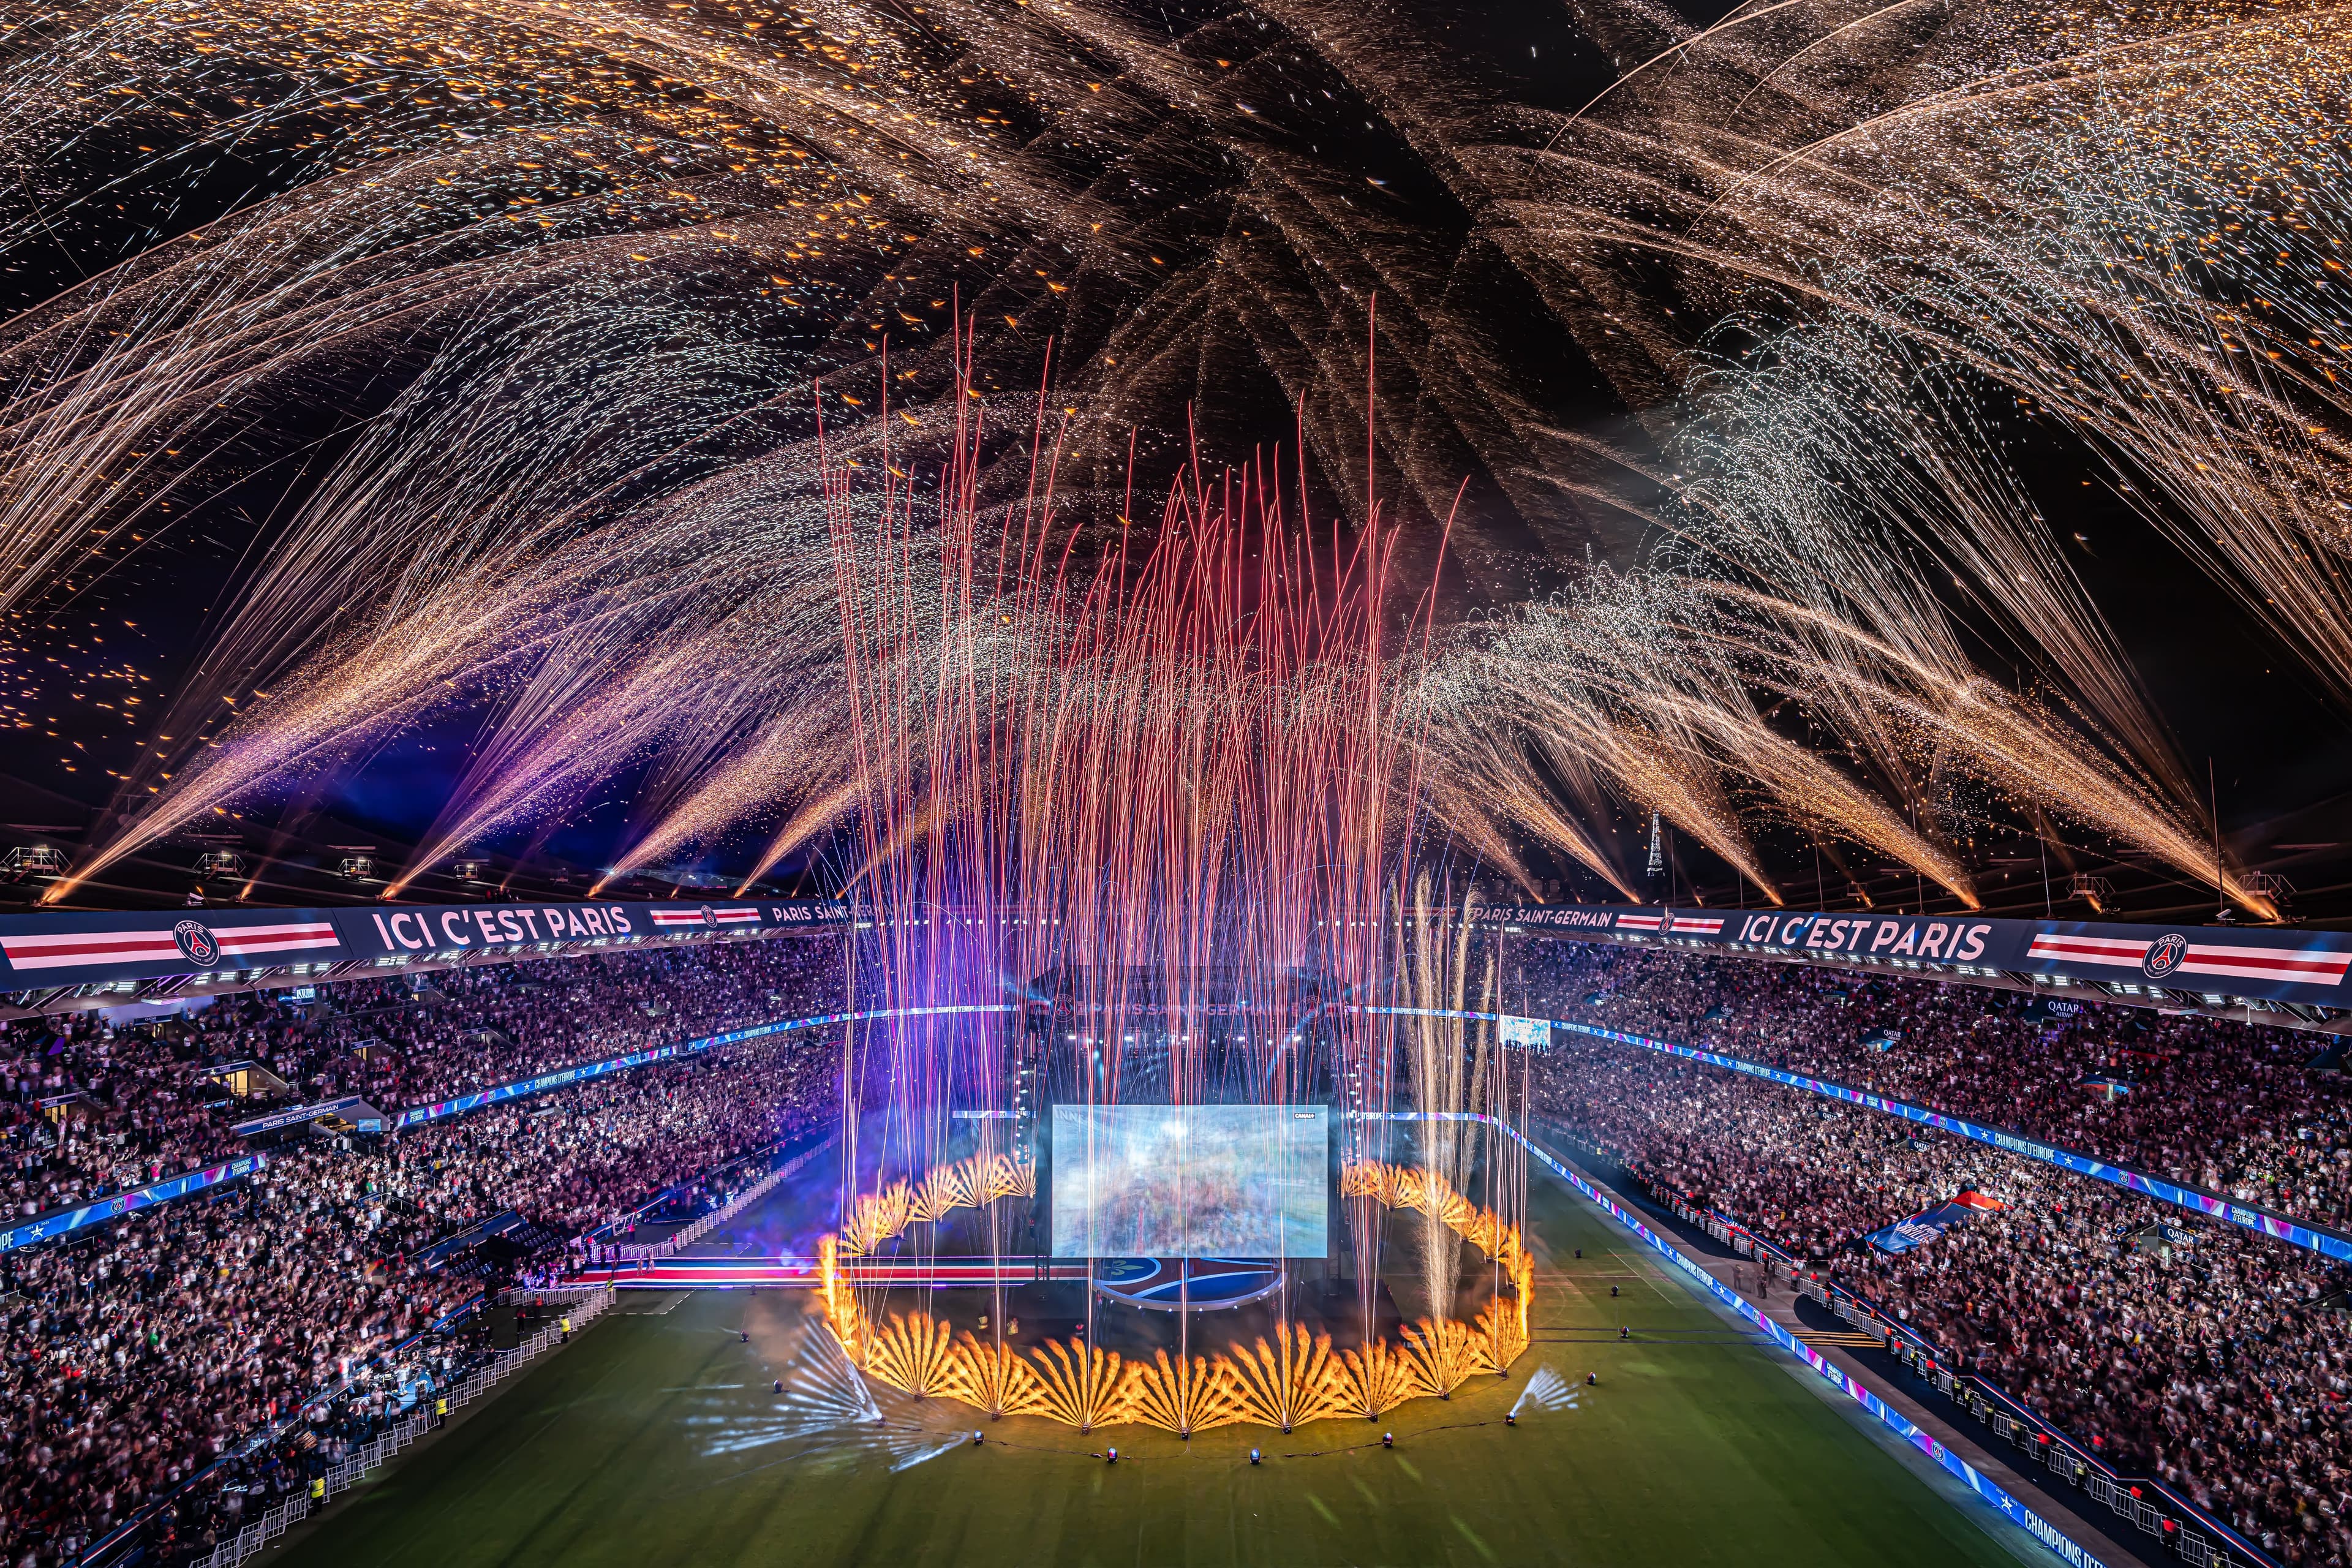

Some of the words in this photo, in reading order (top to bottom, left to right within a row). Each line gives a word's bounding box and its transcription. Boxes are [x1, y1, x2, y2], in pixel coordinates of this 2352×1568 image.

[772, 907, 812, 921] PARIS
[815, 905, 898, 919] SAINT-GERA
[1474, 907, 1513, 921] PARIS
[1515, 909, 1613, 927] SAINT-GERMAIN
[177, 922, 204, 934] PARIS
[372, 913, 436, 950] ICI
[441, 910, 540, 945] C'EST
[543, 907, 631, 938] PARIS
[1738, 915, 1779, 943] ICI
[1782, 916, 1872, 951] C'EST
[1870, 921, 1992, 960] PARIS
[2158, 936, 2184, 948] PARIS
[2048, 1001, 2079, 1012] QATAR
[1883, 1029, 1901, 1038] QATAR
[1736, 1061, 1755, 1074] CHAMPIONS
[1755, 1066, 1771, 1078] D'EUROPE
[535, 1075, 558, 1089] CHAMPIONS
[558, 1070, 576, 1084] D'EUROPE
[263, 1118, 284, 1129] PARIS
[285, 1104, 339, 1123] SAINT-GERMAIN
[1995, 1133, 2026, 1155] CHAMPIONS
[2027, 1142, 2054, 1163] D'EUROPE
[2231, 1206, 2256, 1221] CHAMPIONS
[2233, 1214, 2255, 1227] D'EUROPE
[0, 1231, 13, 1251] PE
[2167, 1228, 2193, 1244] QATAR
[1676, 1252, 1697, 1276] CHAMPIONS
[1697, 1266, 1714, 1289] D'EUROPE
[2025, 1509, 2081, 1568] CHAMPIONS
